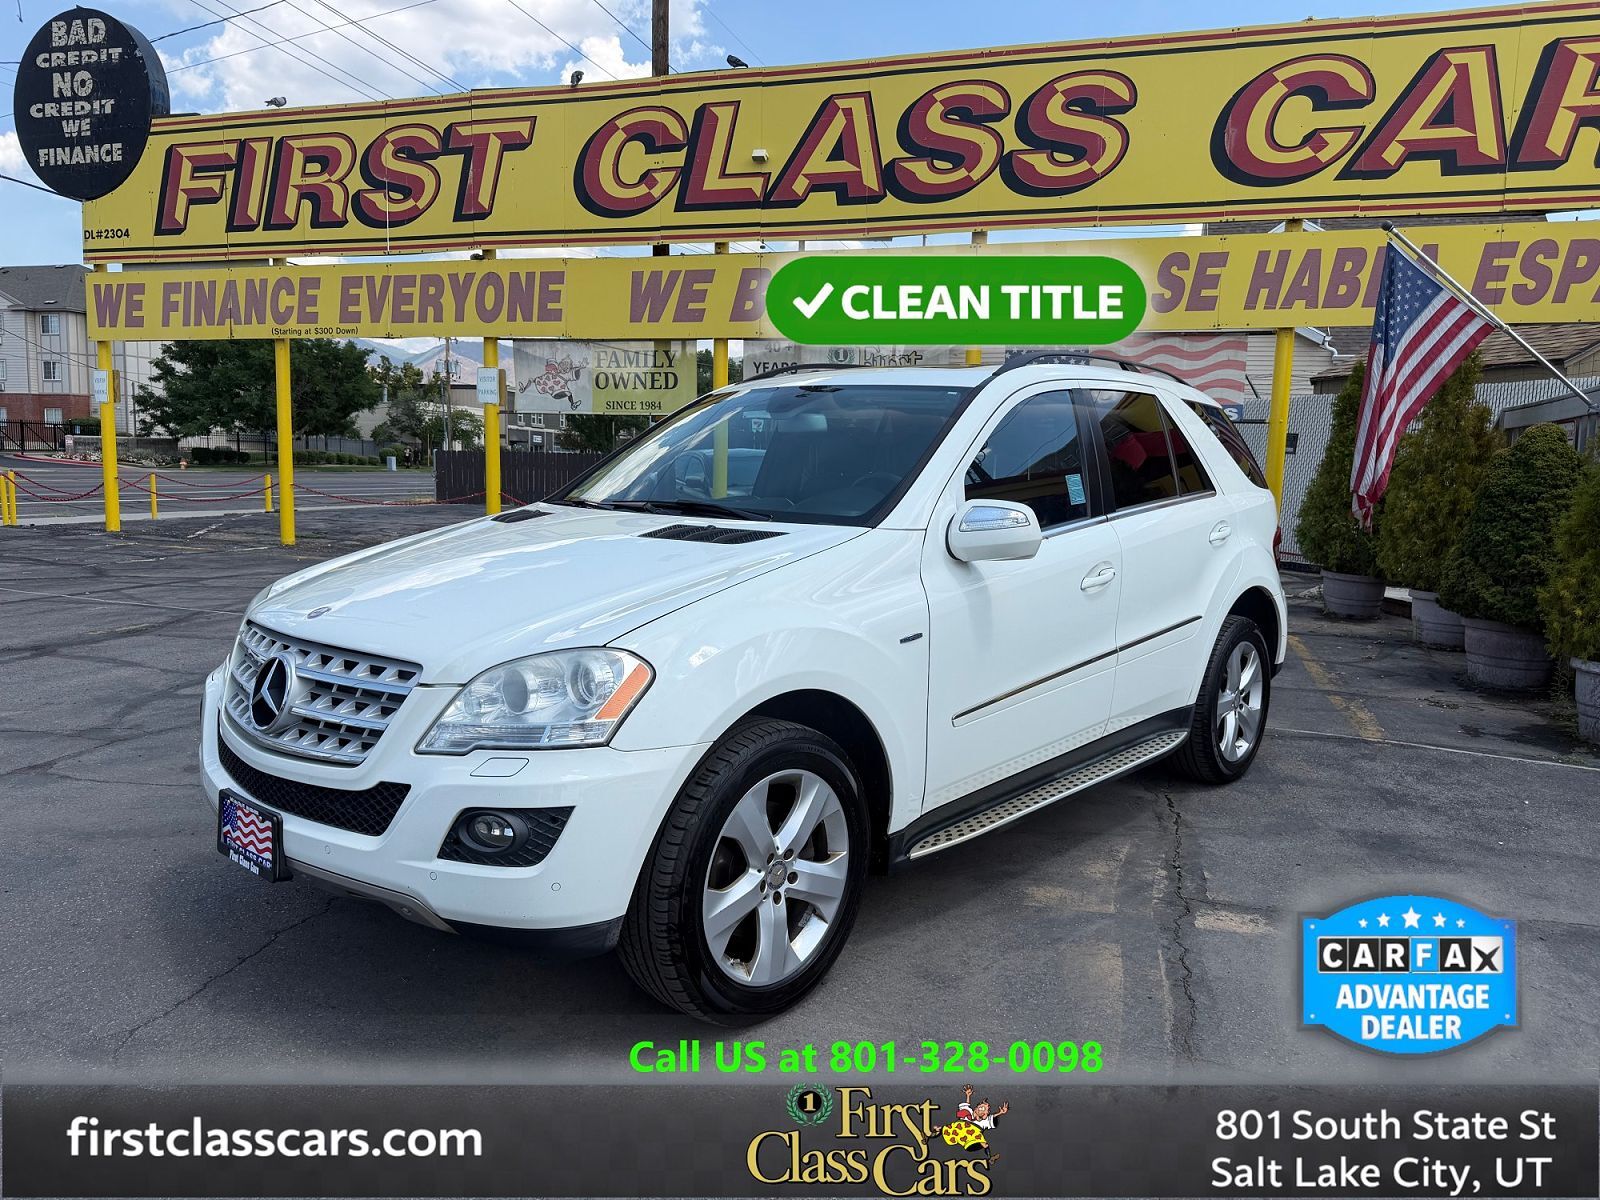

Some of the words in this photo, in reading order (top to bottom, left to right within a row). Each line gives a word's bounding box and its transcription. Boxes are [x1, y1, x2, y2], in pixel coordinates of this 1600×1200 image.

[51, 18, 106, 47] BAD
[35, 48, 123, 68] CREDIT
[52, 70, 93, 98] NO
[29, 99, 115, 118] CREDIT
[61, 118, 92, 137] WE
[38, 143, 123, 167] FINANCE
[154, 116, 538, 236] FIRST
[573, 69, 1138, 218] CLASS
[84, 228, 130, 240] DL#2304
[1151, 251, 1230, 313] SE
[1471, 238, 1600, 306] ESP
[93, 283, 145, 328] WE
[161, 276, 321, 328] FINANCE
[339, 270, 565, 325] EVERYONE
[630, 269, 716, 323] WE
[271, 327, 302, 336] (Starting
[314, 327, 334, 335] $300
[336, 326, 359, 335] Down)
[594, 350, 678, 369] FAMILY
[594, 371, 679, 390] OWNED
[605, 401, 637, 410] SINCE
[639, 401, 662, 410] 1984
